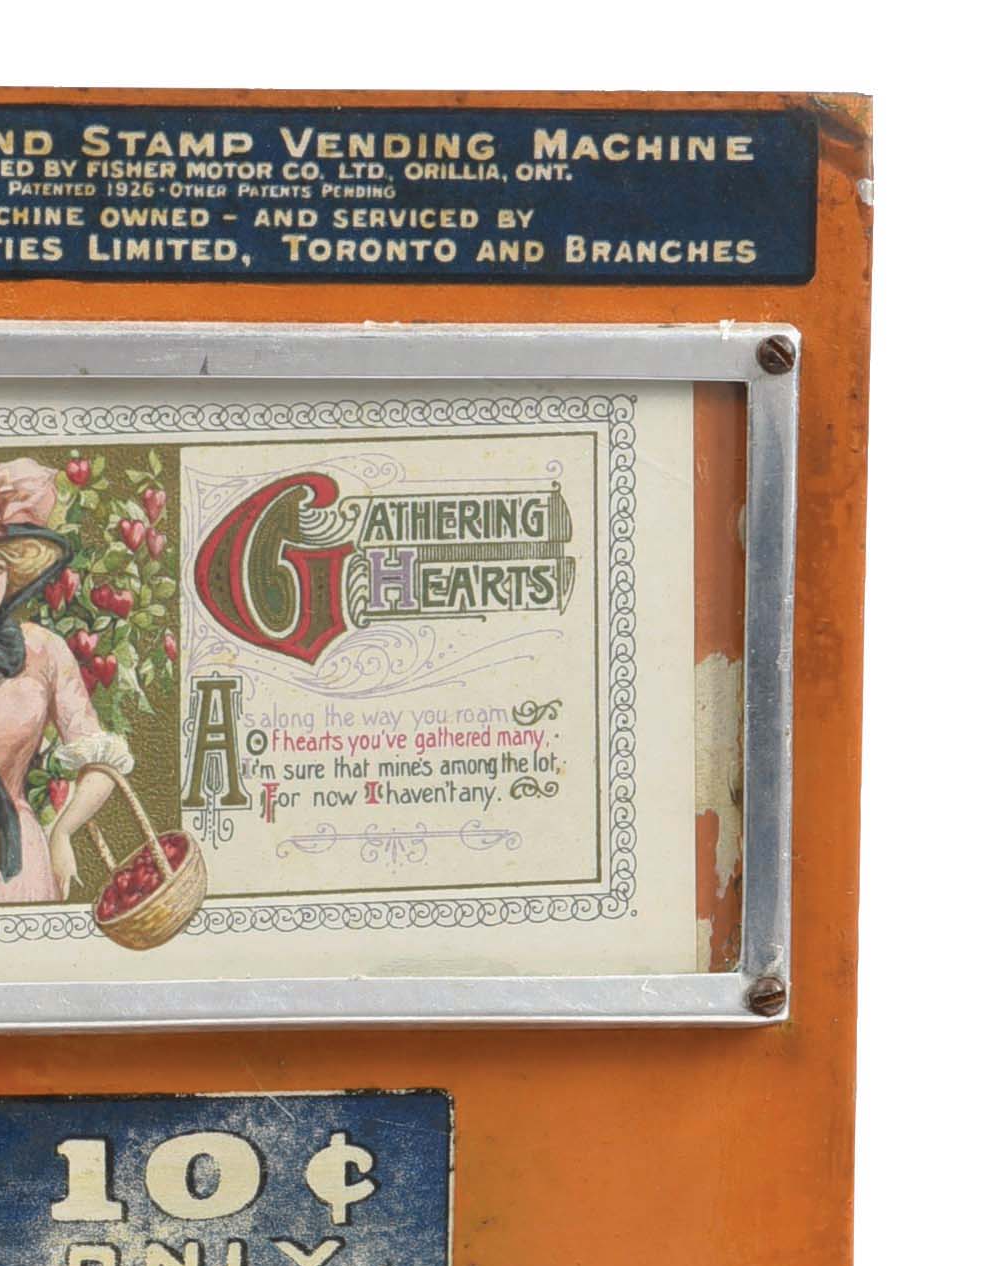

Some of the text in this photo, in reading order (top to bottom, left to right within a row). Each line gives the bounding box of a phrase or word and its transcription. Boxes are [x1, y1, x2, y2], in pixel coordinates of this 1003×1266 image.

[43, 160, 77, 178] BY
[86, 160, 177, 179] FISHER
[186, 161, 274, 180] MOTOR
[282, 162, 325, 181] CO.
[404, 162, 508, 183] ORILLIA,
[515, 163, 574, 182] ONT.
[100, 207, 210, 229] OWNED
[254, 208, 318, 228] AND
[333, 208, 479, 230] SERVICED
[497, 209, 534, 229] BY
[476, 239, 545, 263] AND
[260, 702, 315, 734] along
[325, 702, 355, 727] the
[361, 711, 402, 731] way
[412, 709, 448, 732] you
[456, 706, 509, 724] roam
[282, 729, 344, 753] hearts
[347, 730, 407, 757] you've
[414, 725, 492, 756] gathered
[283, 762, 326, 781] sure
[334, 755, 370, 778] that
[378, 754, 434, 777] mine's
[439, 757, 498, 780] among
[500, 751, 529, 774] the
[533, 750, 561, 775] lot,
[259, 780, 503, 824] For now I haven't any.
